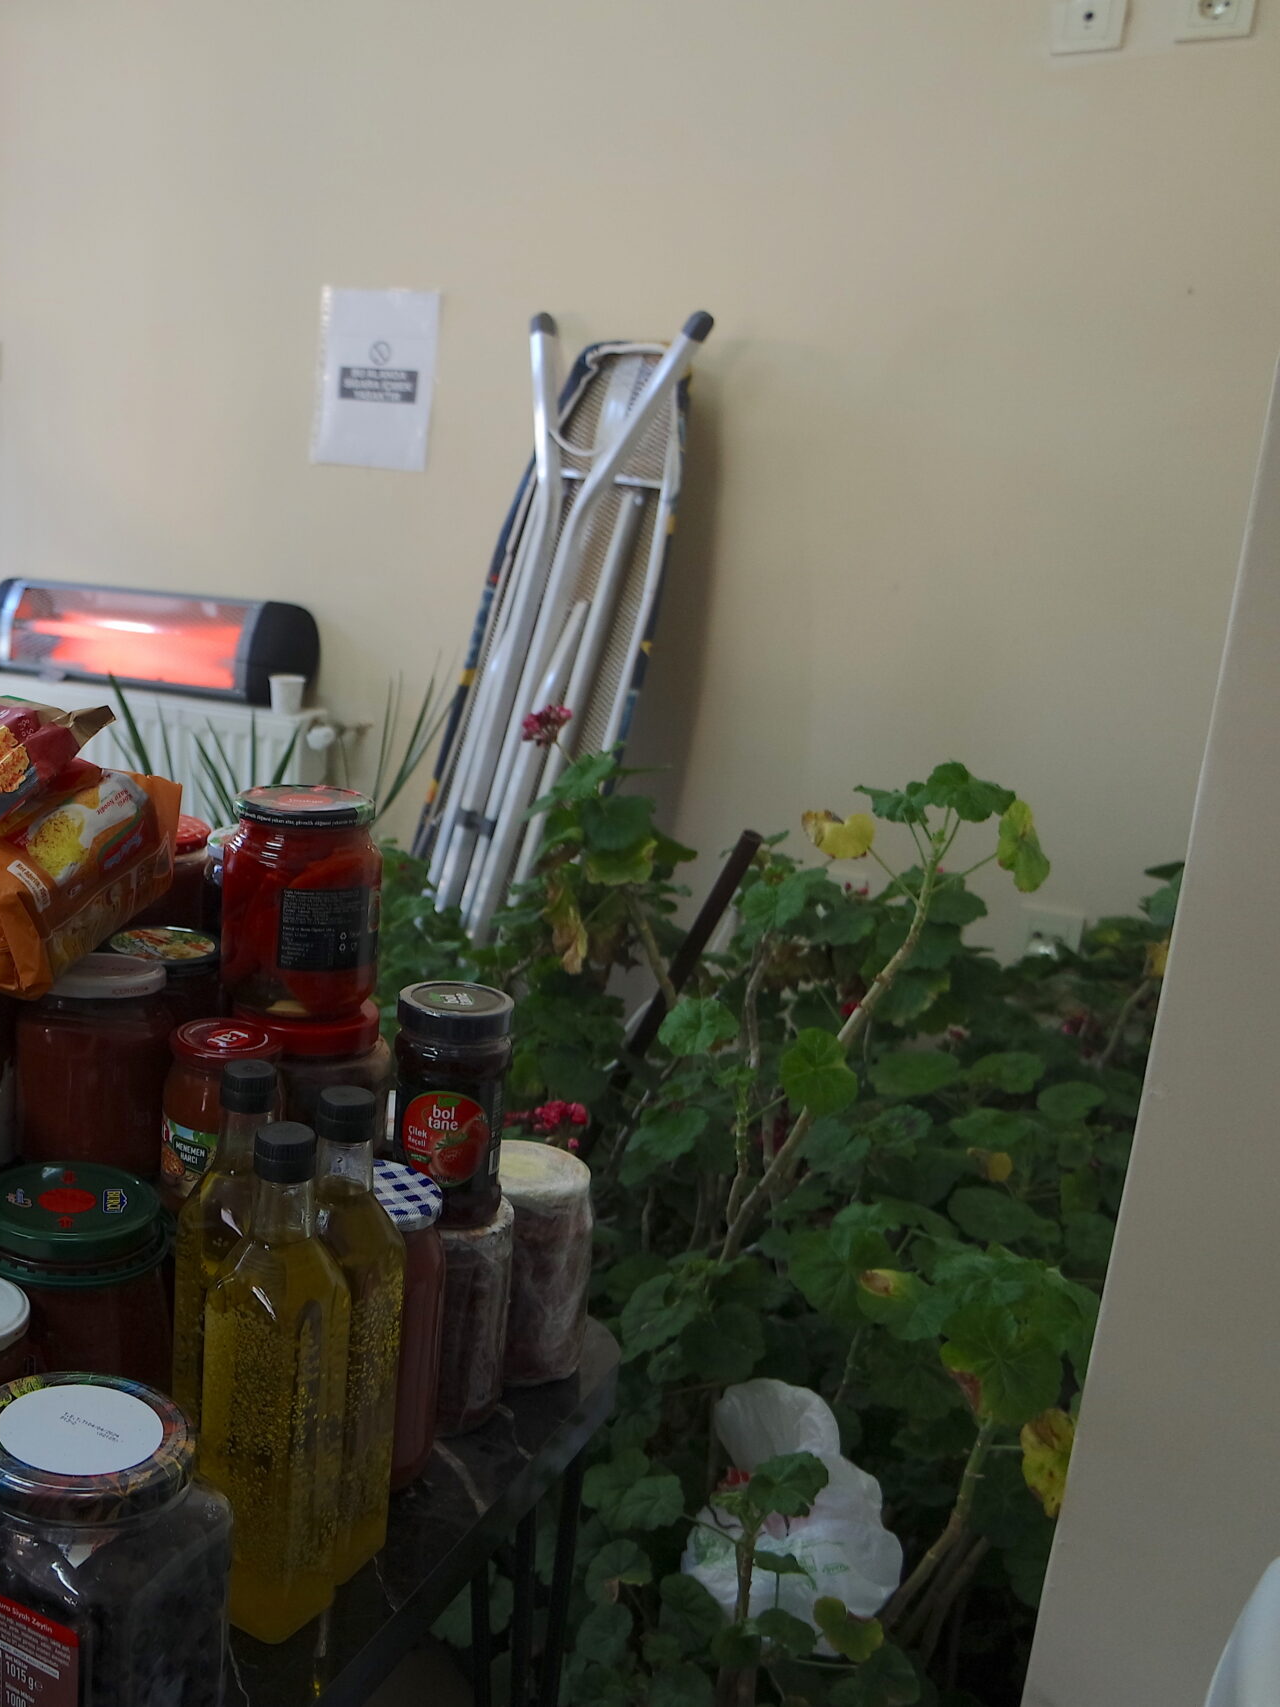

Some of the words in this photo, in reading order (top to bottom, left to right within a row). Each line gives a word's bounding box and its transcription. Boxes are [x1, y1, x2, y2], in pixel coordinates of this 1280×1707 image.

[432, 1105, 456, 1120] bol
[408, 1125, 428, 1139] Çilek
[428, 1118, 459, 1132] tane
[176, 1142, 205, 1157] MENEMEN
[12, 1605, 31, 1623] Siyah
[32, 1617, 53, 1634] Zeytin
[5, 1660, 26, 1686] 1015
